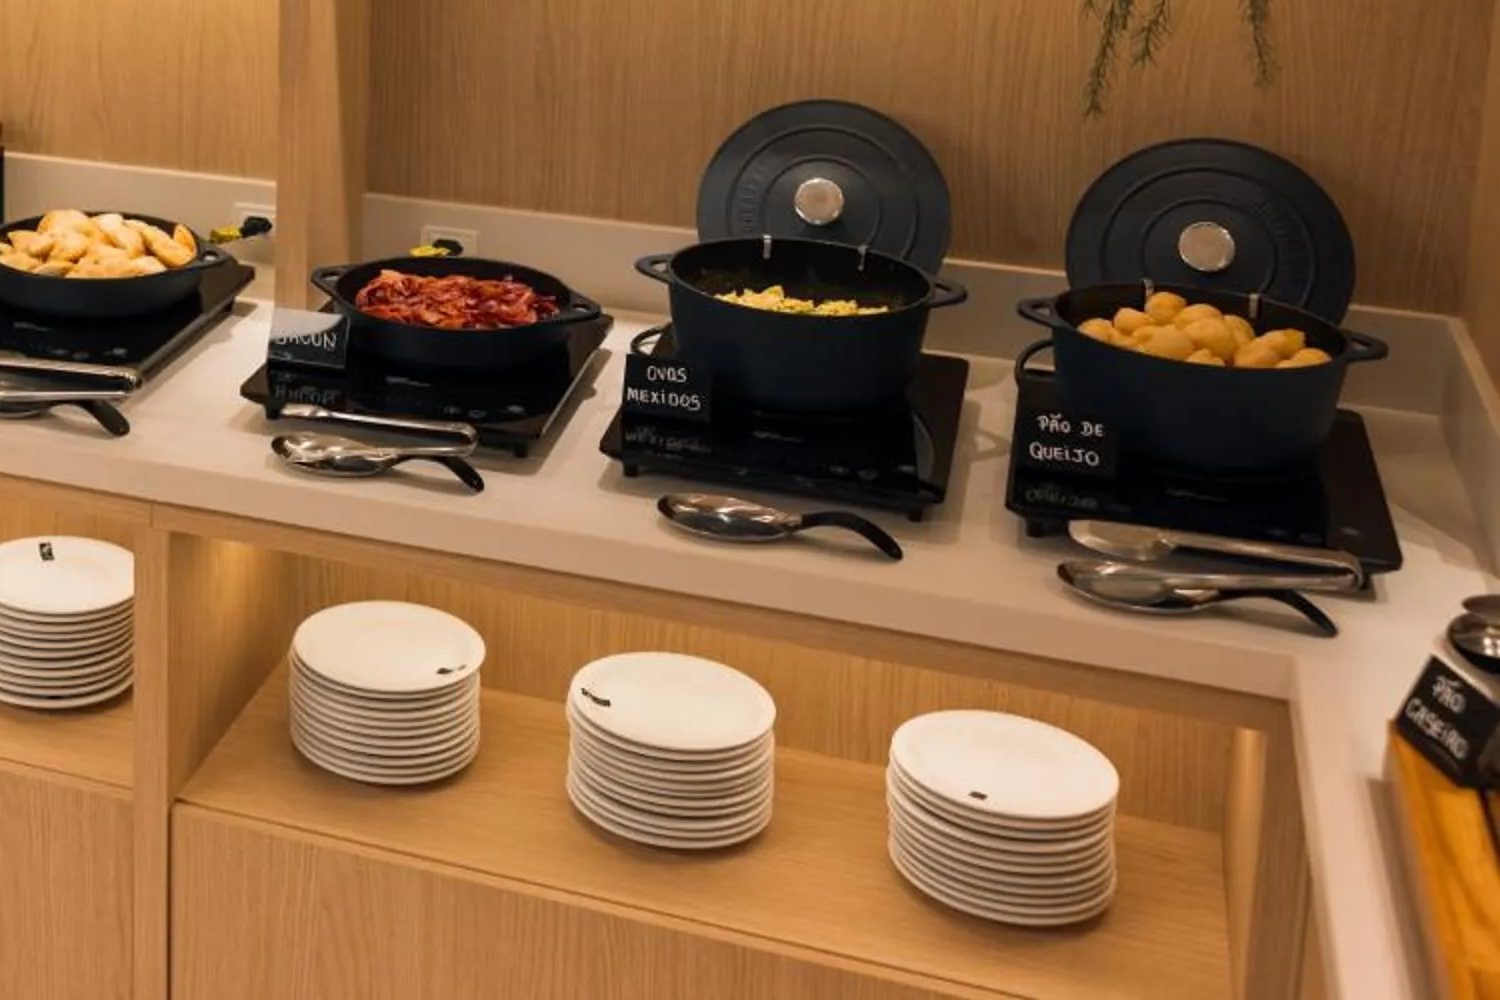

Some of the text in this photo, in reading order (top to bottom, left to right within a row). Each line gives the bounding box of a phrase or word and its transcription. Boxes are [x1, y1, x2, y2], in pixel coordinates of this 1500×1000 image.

[646, 365, 688, 383] OVOS
[1037, 413, 1106, 437] PÃO DE
